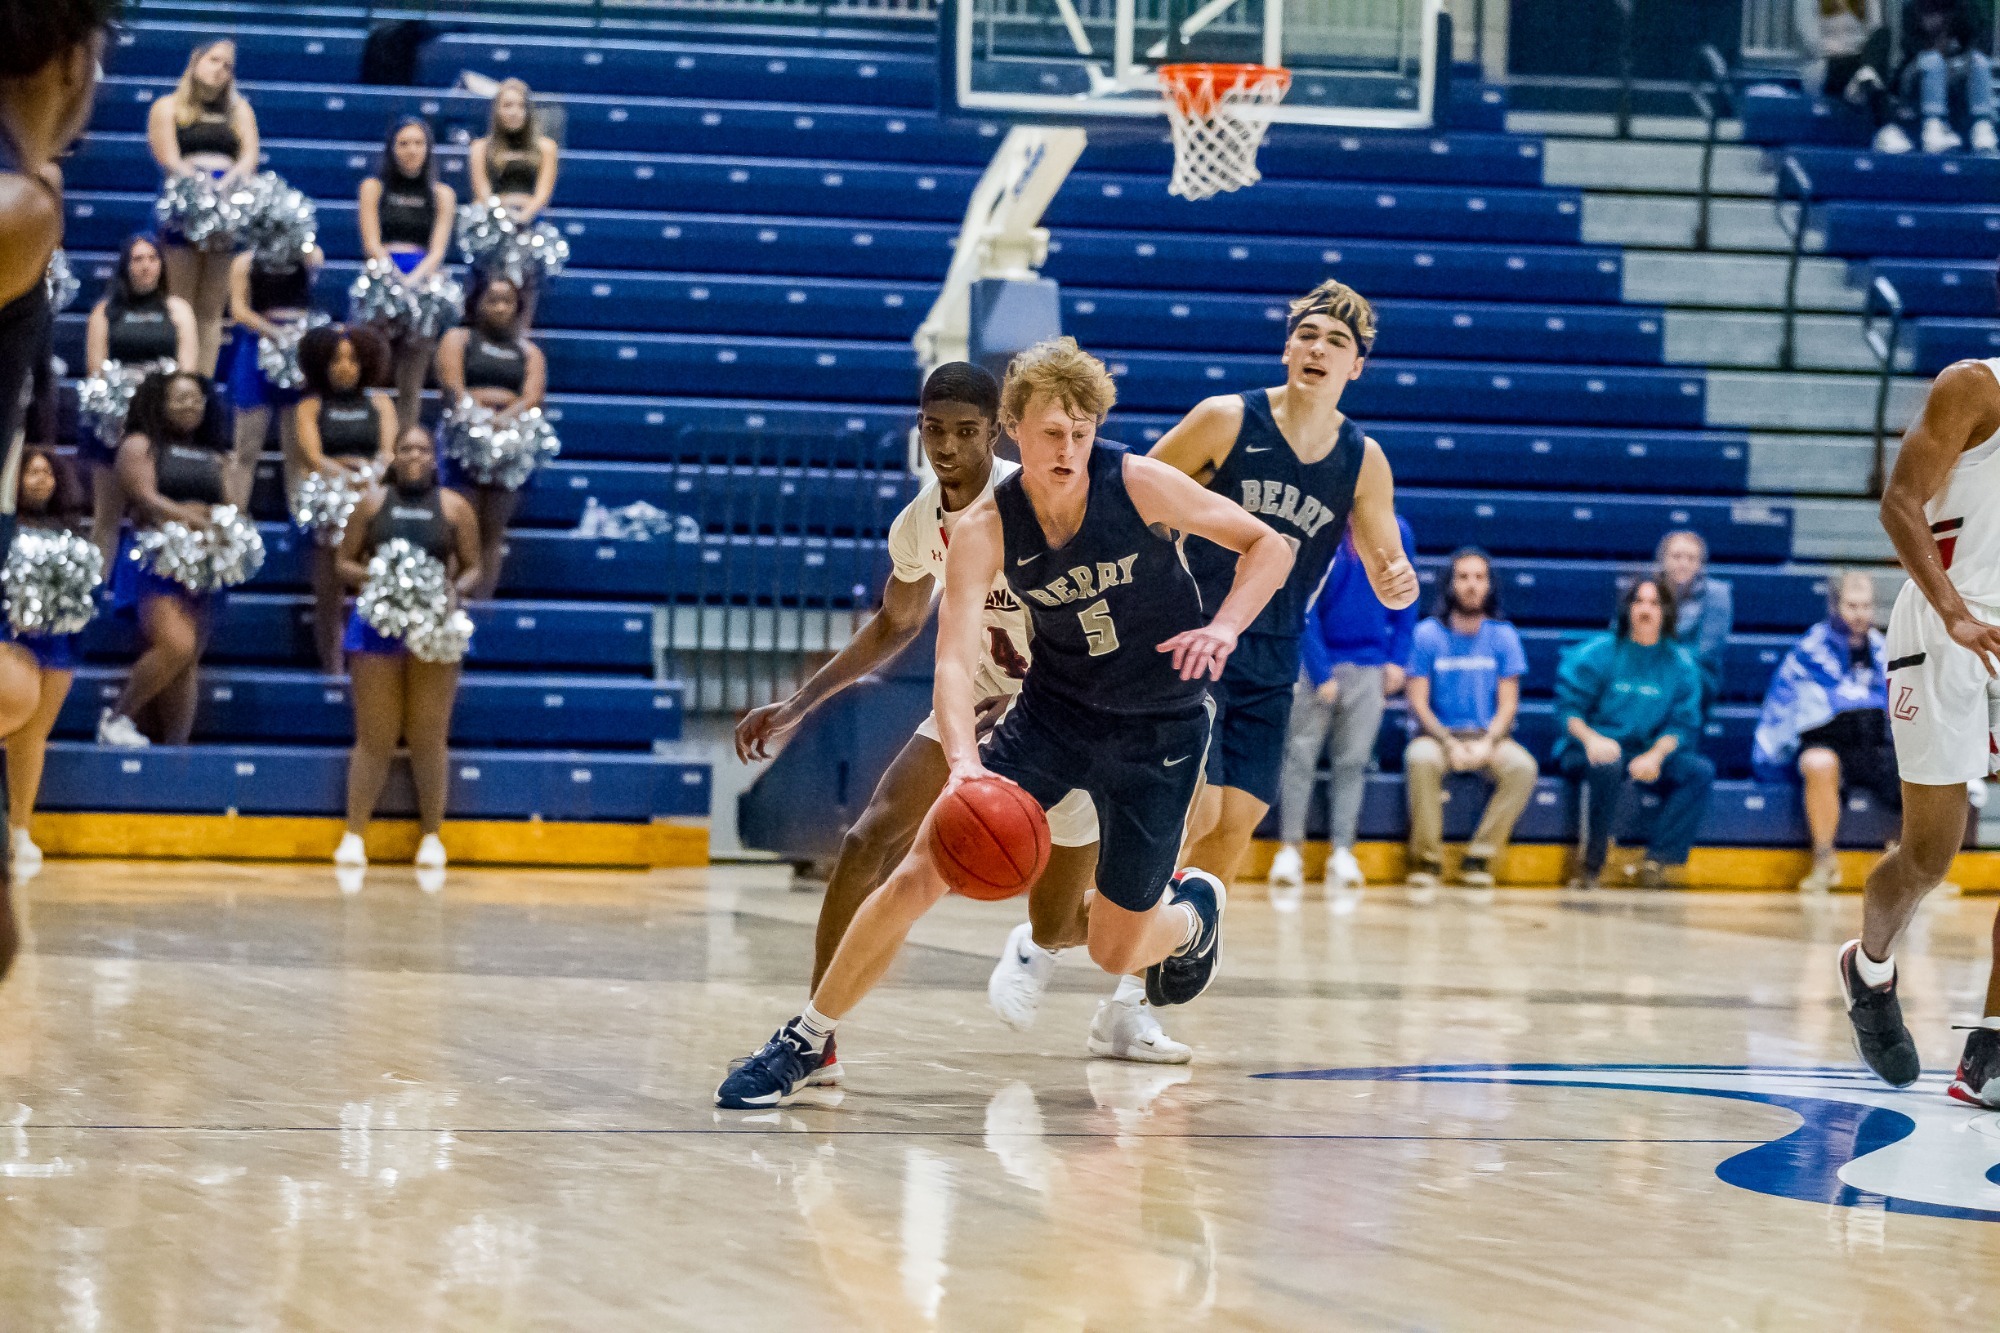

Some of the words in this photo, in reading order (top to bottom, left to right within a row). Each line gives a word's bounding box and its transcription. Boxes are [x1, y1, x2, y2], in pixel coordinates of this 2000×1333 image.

[1241, 479, 1336, 538] BERRY
[1026, 552, 1139, 607] BERRY
[1077, 598, 1120, 657] 5
[1893, 686, 1919, 721] L
